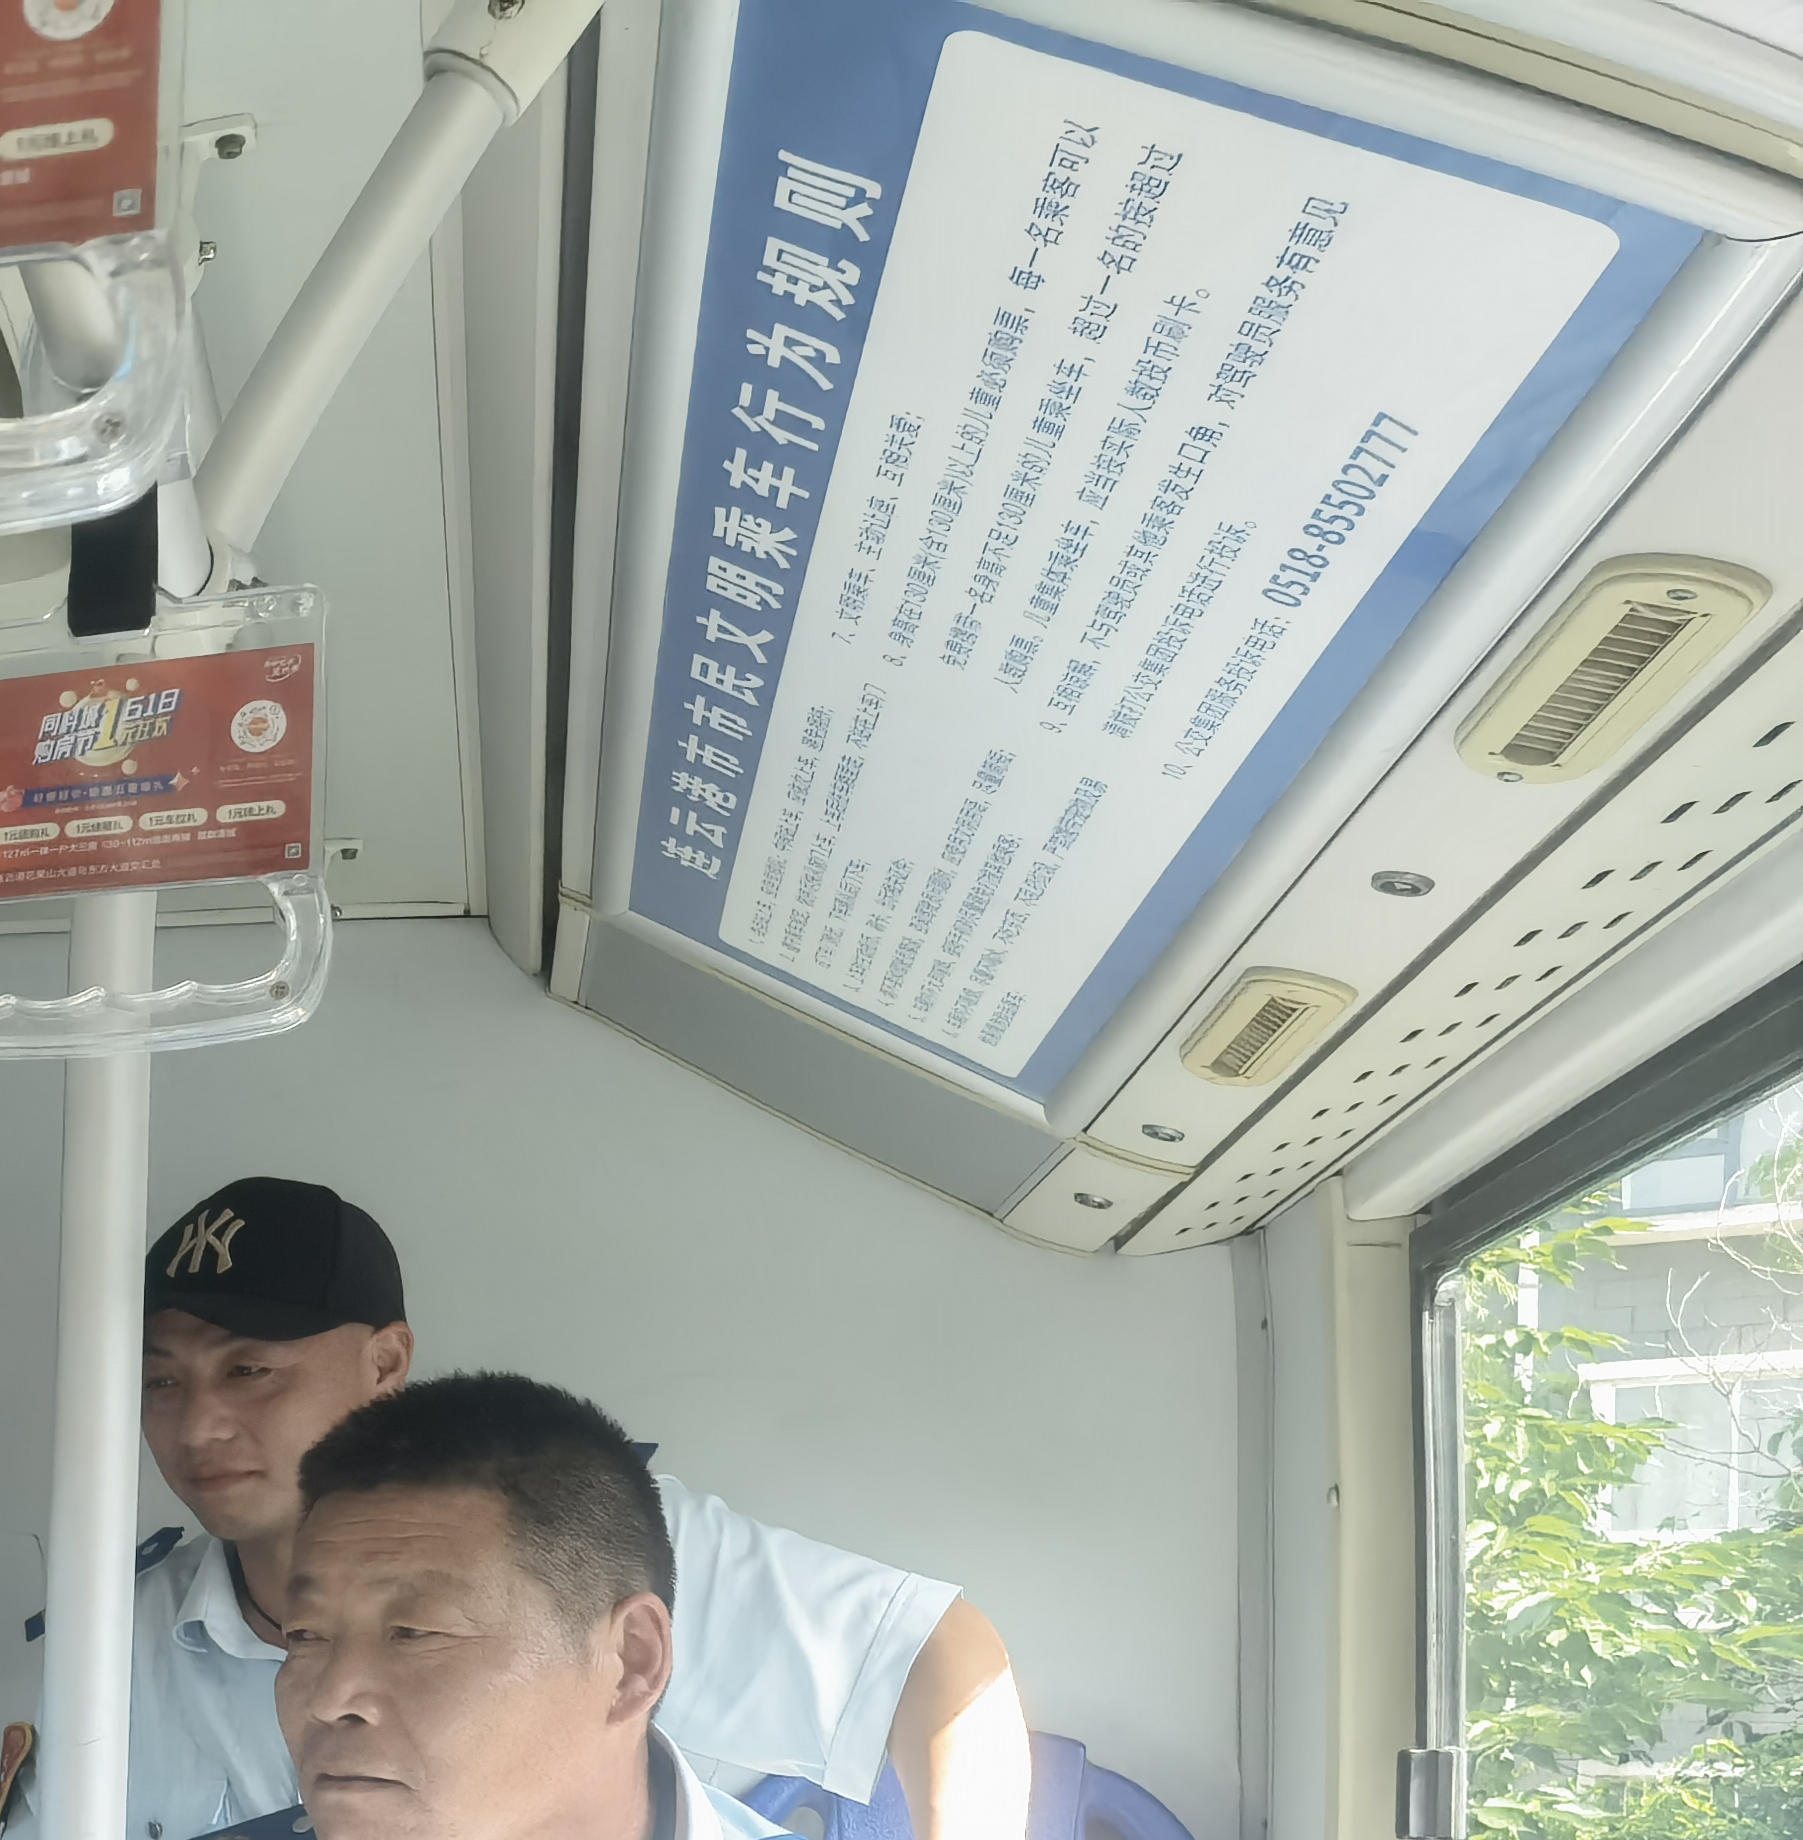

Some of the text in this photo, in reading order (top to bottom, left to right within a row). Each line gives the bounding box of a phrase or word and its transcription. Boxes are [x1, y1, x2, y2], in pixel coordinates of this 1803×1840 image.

[659, 144, 888, 883] 连云港市市民文明乘车行为规则
